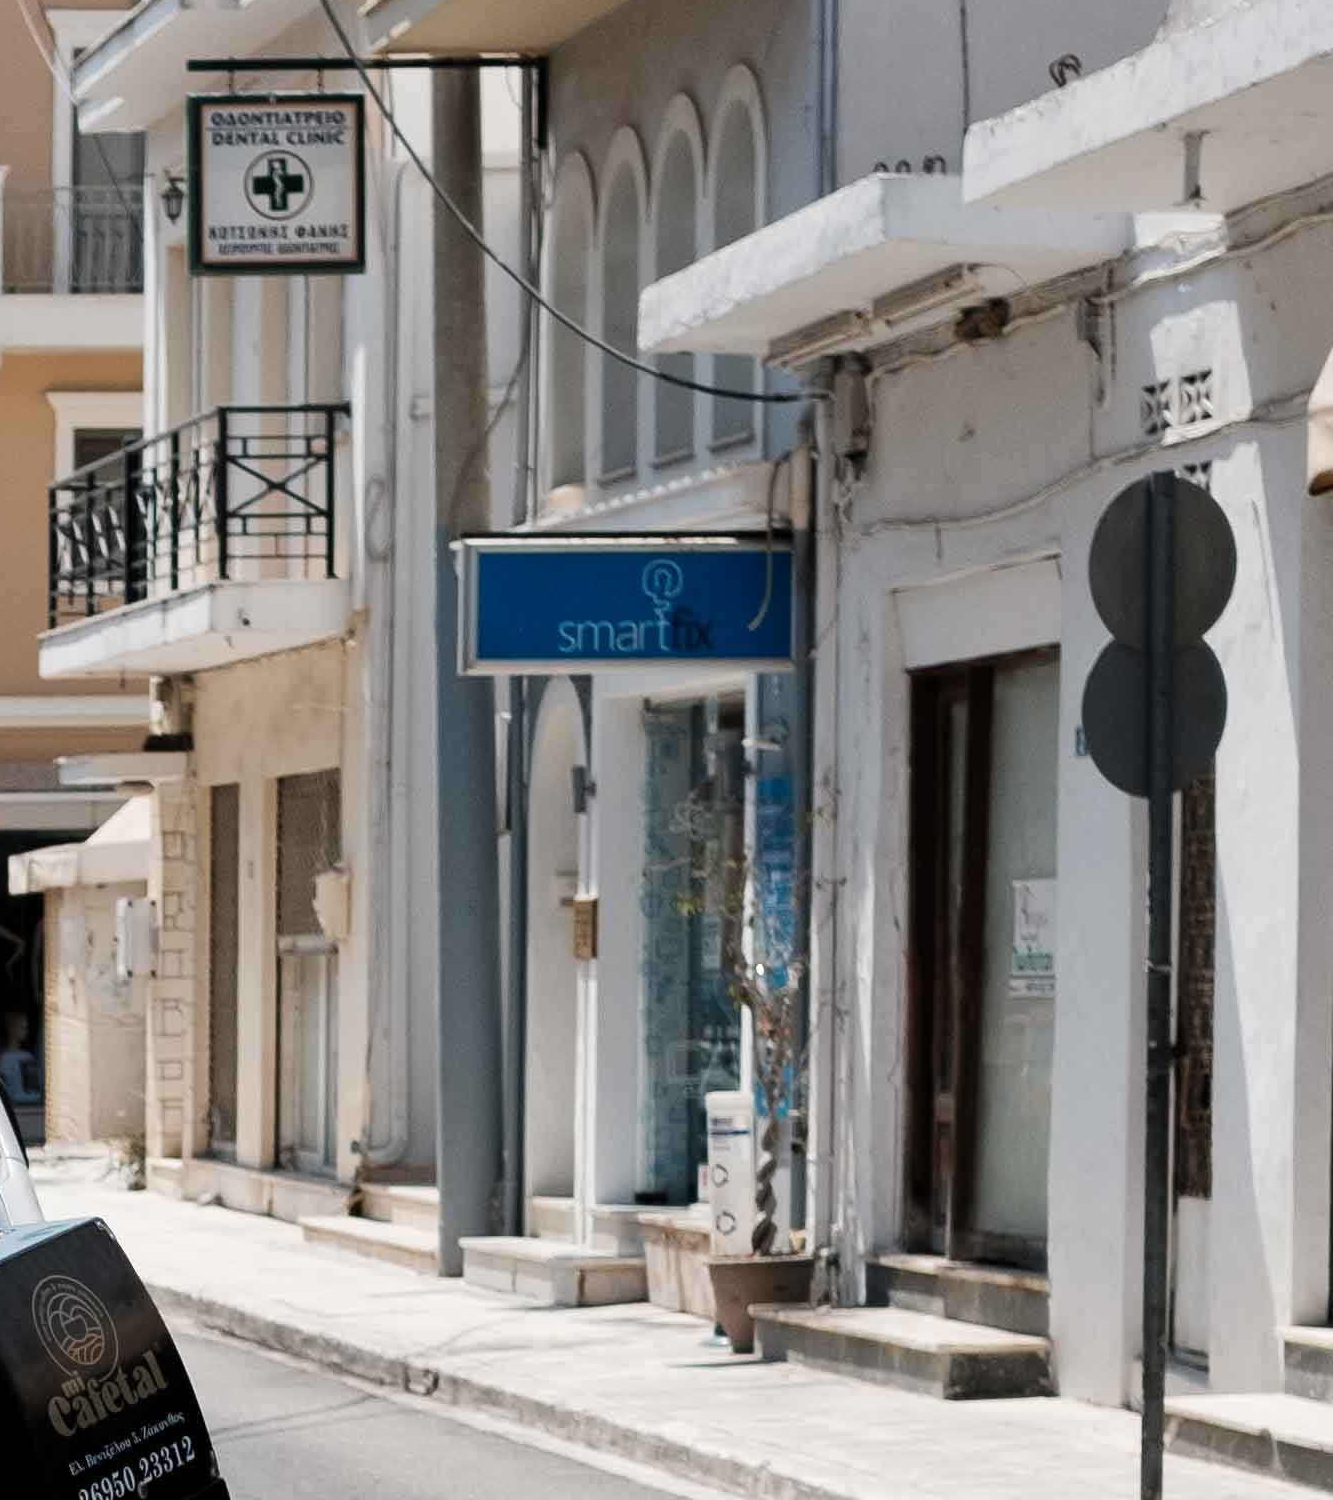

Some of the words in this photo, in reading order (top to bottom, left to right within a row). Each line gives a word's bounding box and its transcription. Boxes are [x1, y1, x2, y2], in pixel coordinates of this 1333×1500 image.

[212, 131, 279, 146] DENTAL
[286, 131, 344, 145] CLINIC
[48, 1350, 168, 1437] Cafetal
[61, 1370, 85, 1398] mi
[138, 1435, 196, 1484] 23312
